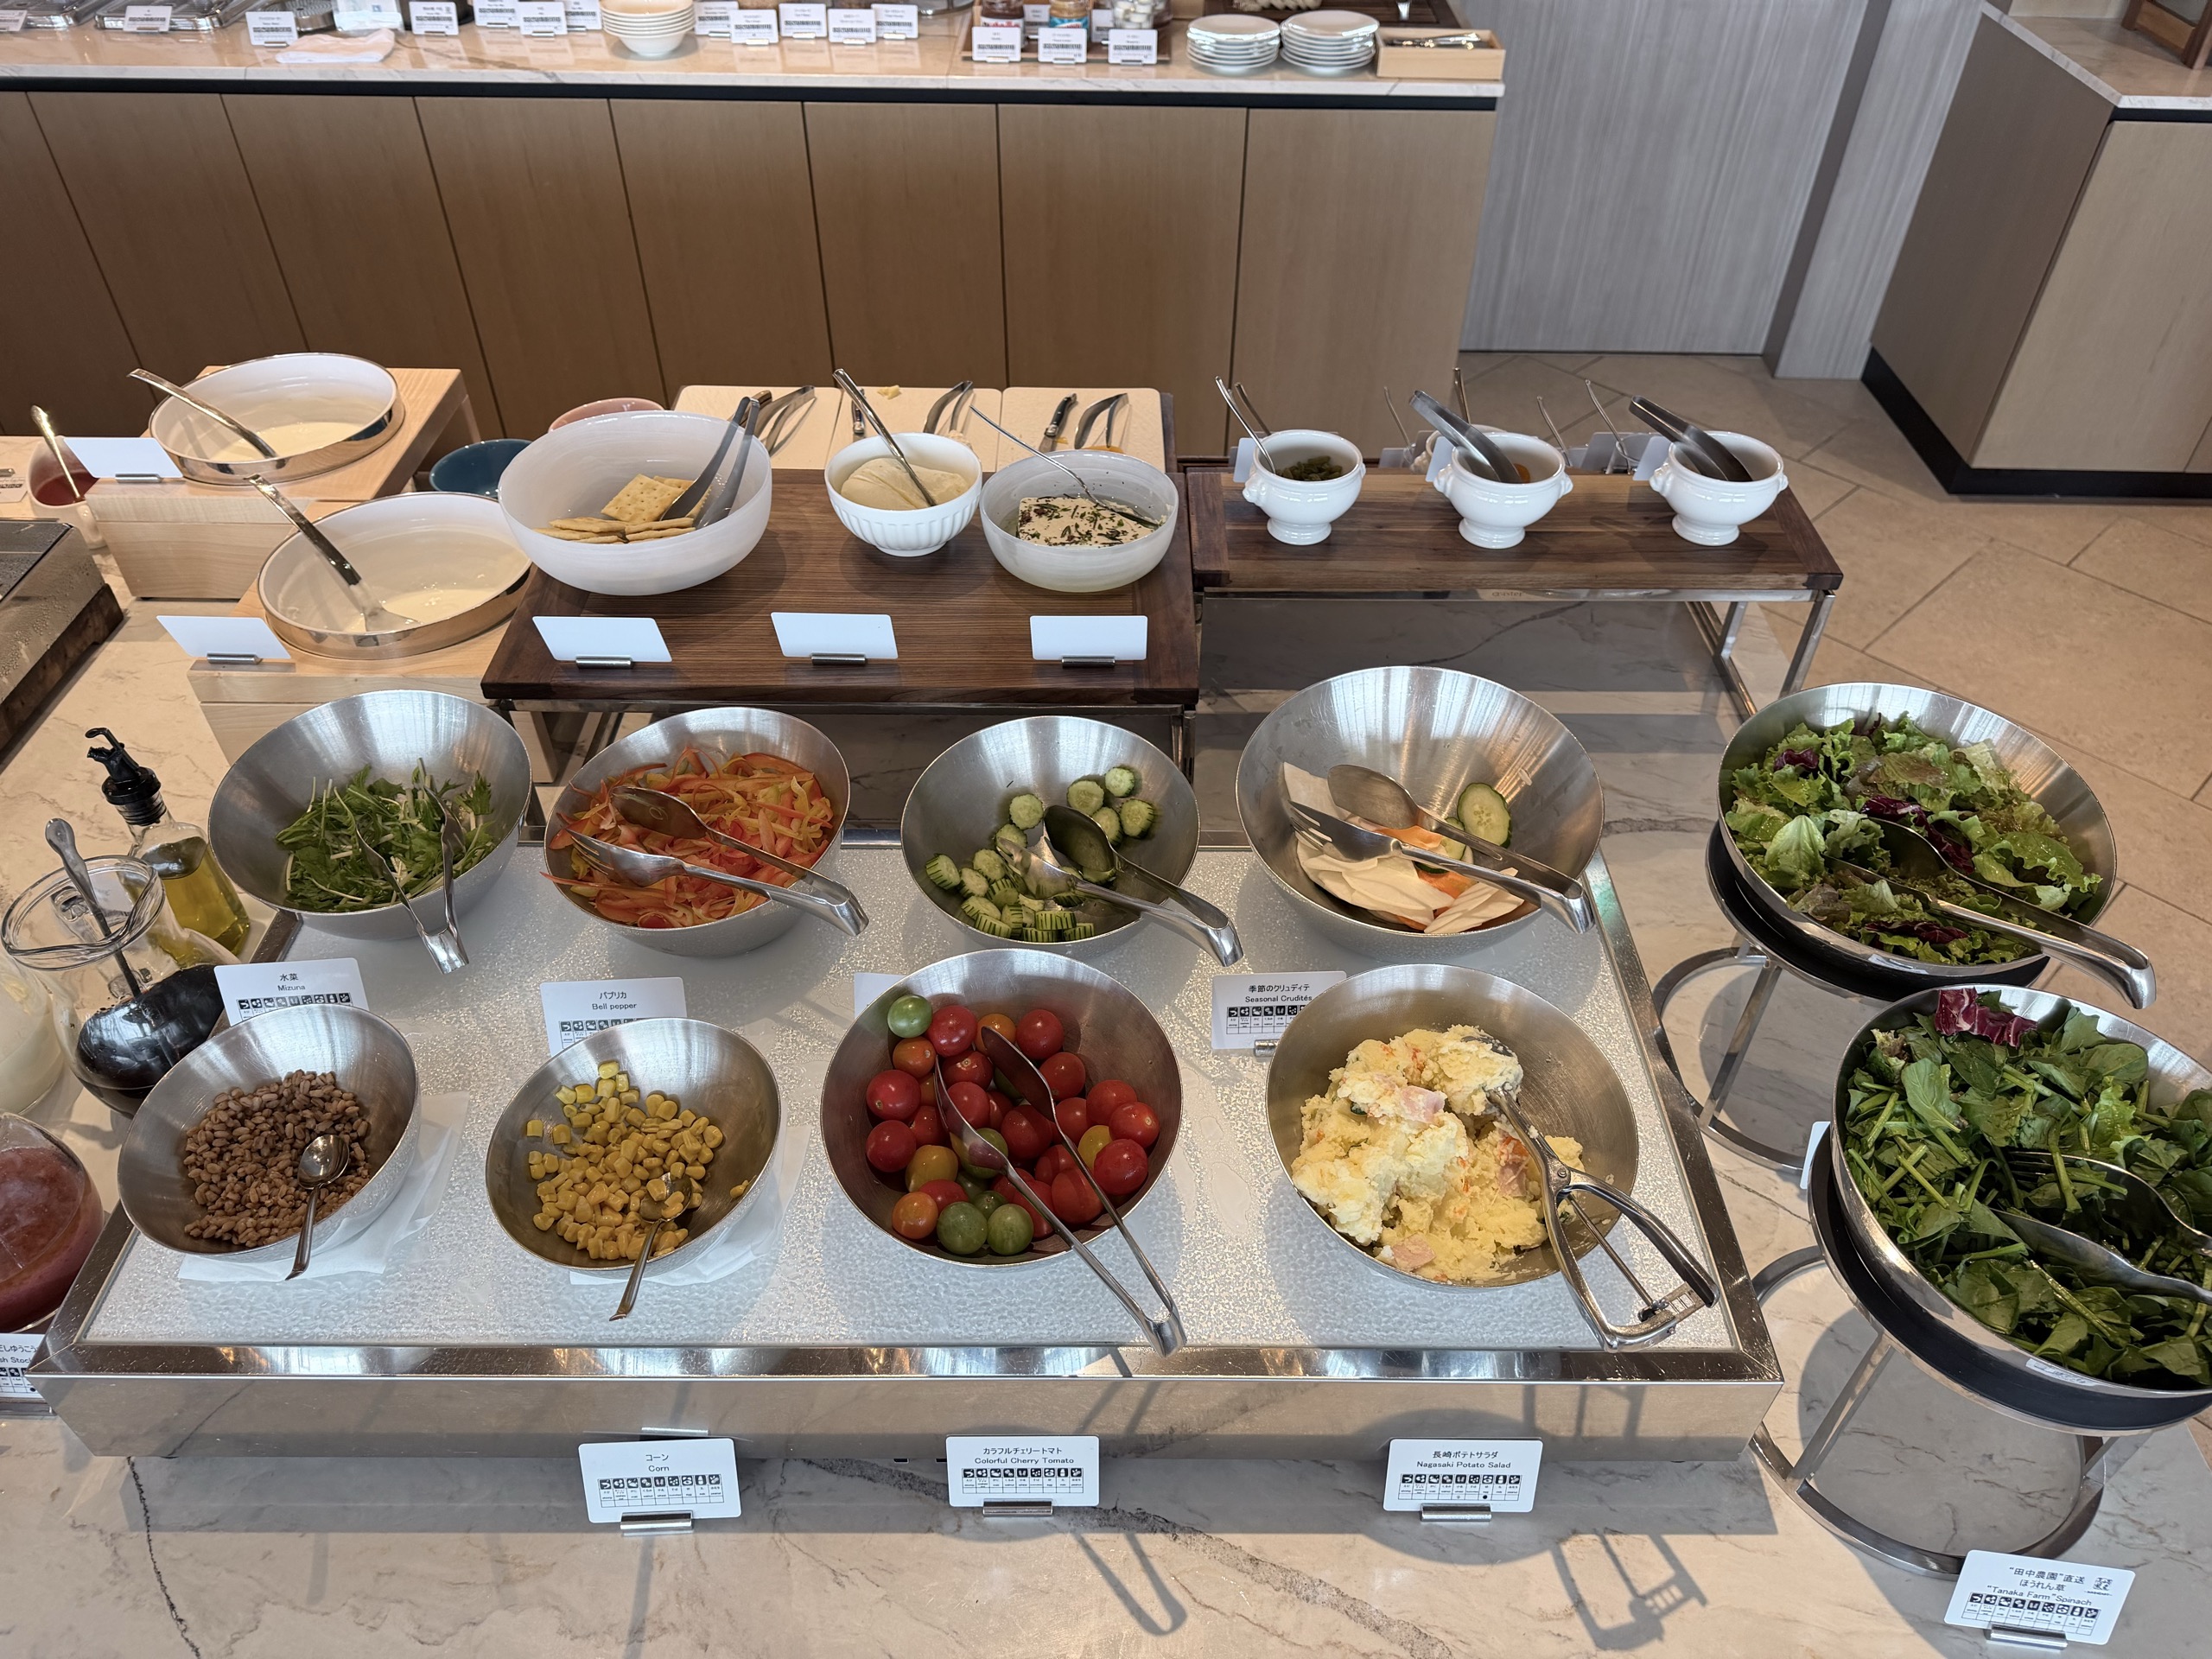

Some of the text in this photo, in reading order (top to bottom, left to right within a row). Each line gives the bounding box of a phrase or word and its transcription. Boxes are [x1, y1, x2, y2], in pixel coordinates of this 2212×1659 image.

[279, 973, 299, 982] 水菜
[1249, 984, 1310, 993] 季節のクリュディテ
[2019, 1579, 2066, 1592] ほうれん草
